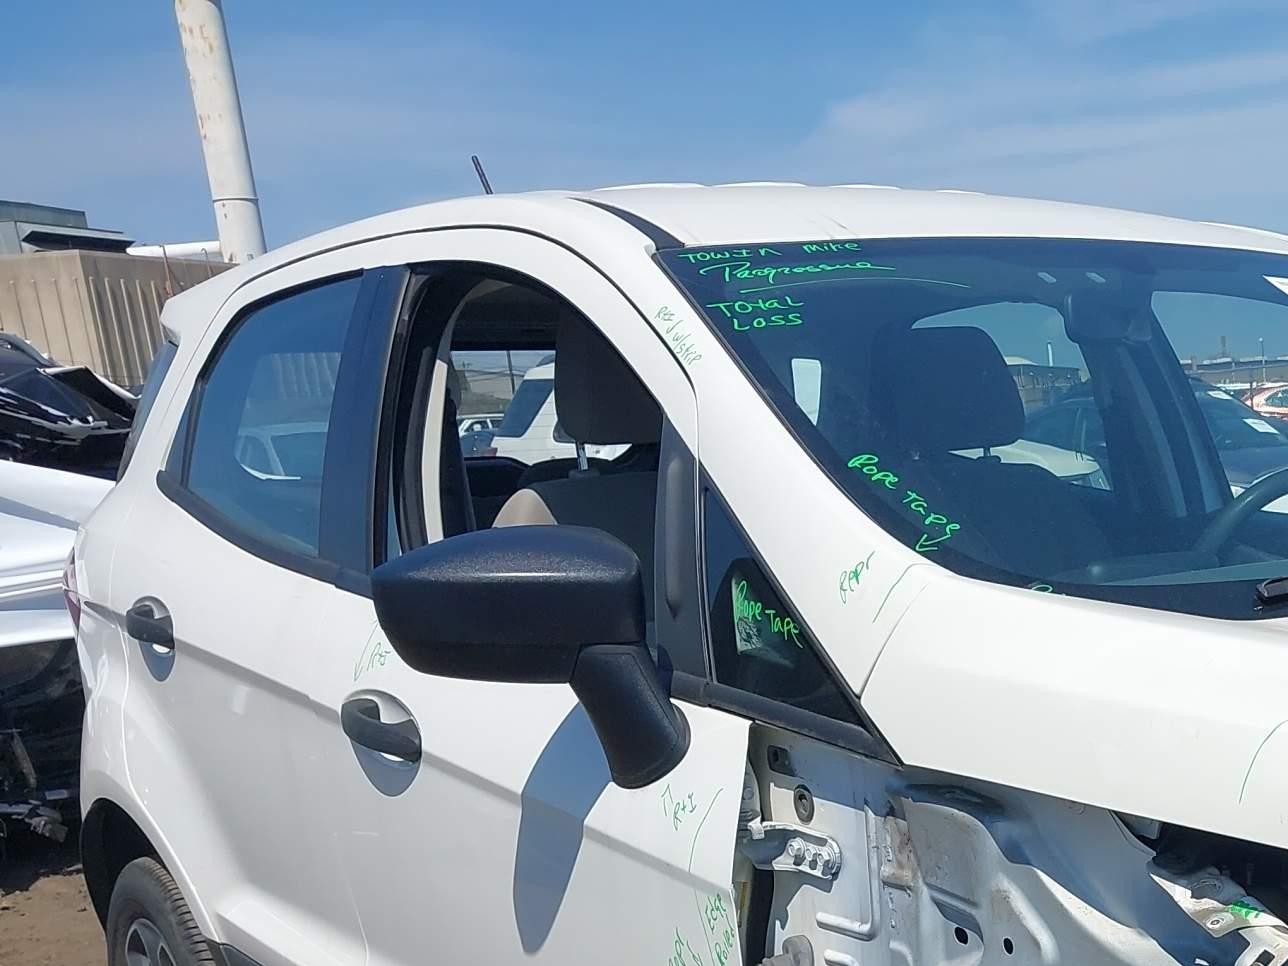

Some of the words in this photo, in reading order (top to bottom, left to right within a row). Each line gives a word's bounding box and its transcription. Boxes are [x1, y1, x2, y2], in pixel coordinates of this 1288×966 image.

[847, 454, 898, 490] Rope
[902, 491, 961, 536] Tape
[735, 580, 763, 622] Rope
[765, 609, 804, 649] Tape
